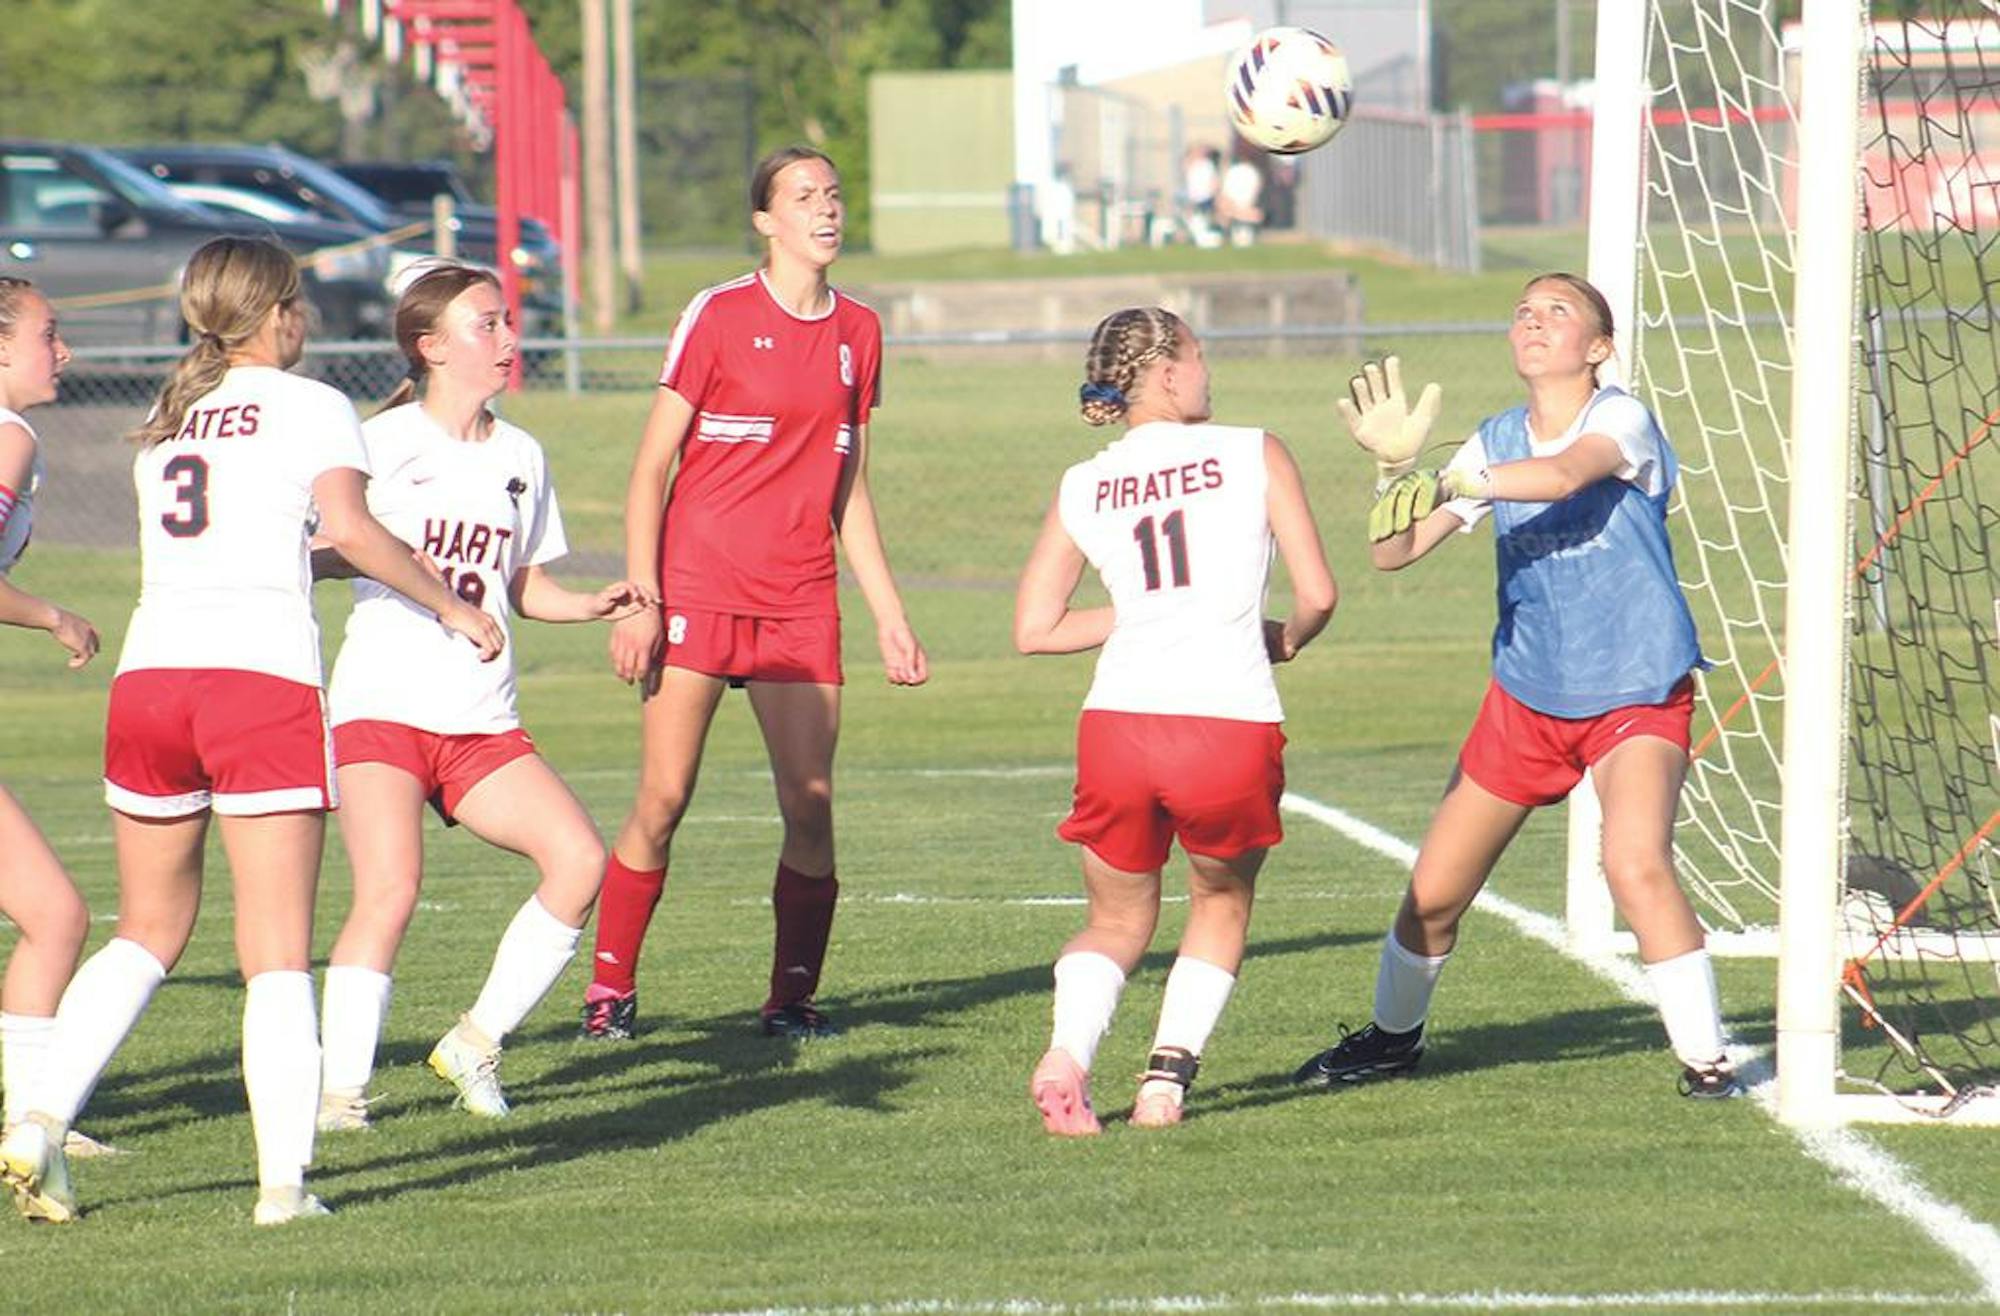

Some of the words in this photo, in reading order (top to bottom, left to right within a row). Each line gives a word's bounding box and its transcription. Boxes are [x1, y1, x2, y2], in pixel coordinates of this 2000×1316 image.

[838, 342, 854, 387] 8
[178, 403, 261, 441] ATES
[161, 453, 210, 538] 3
[1095, 457, 1224, 514] PIRATES
[423, 517, 512, 572] HART
[1132, 508, 1191, 592] 11
[668, 613, 688, 645] 8
